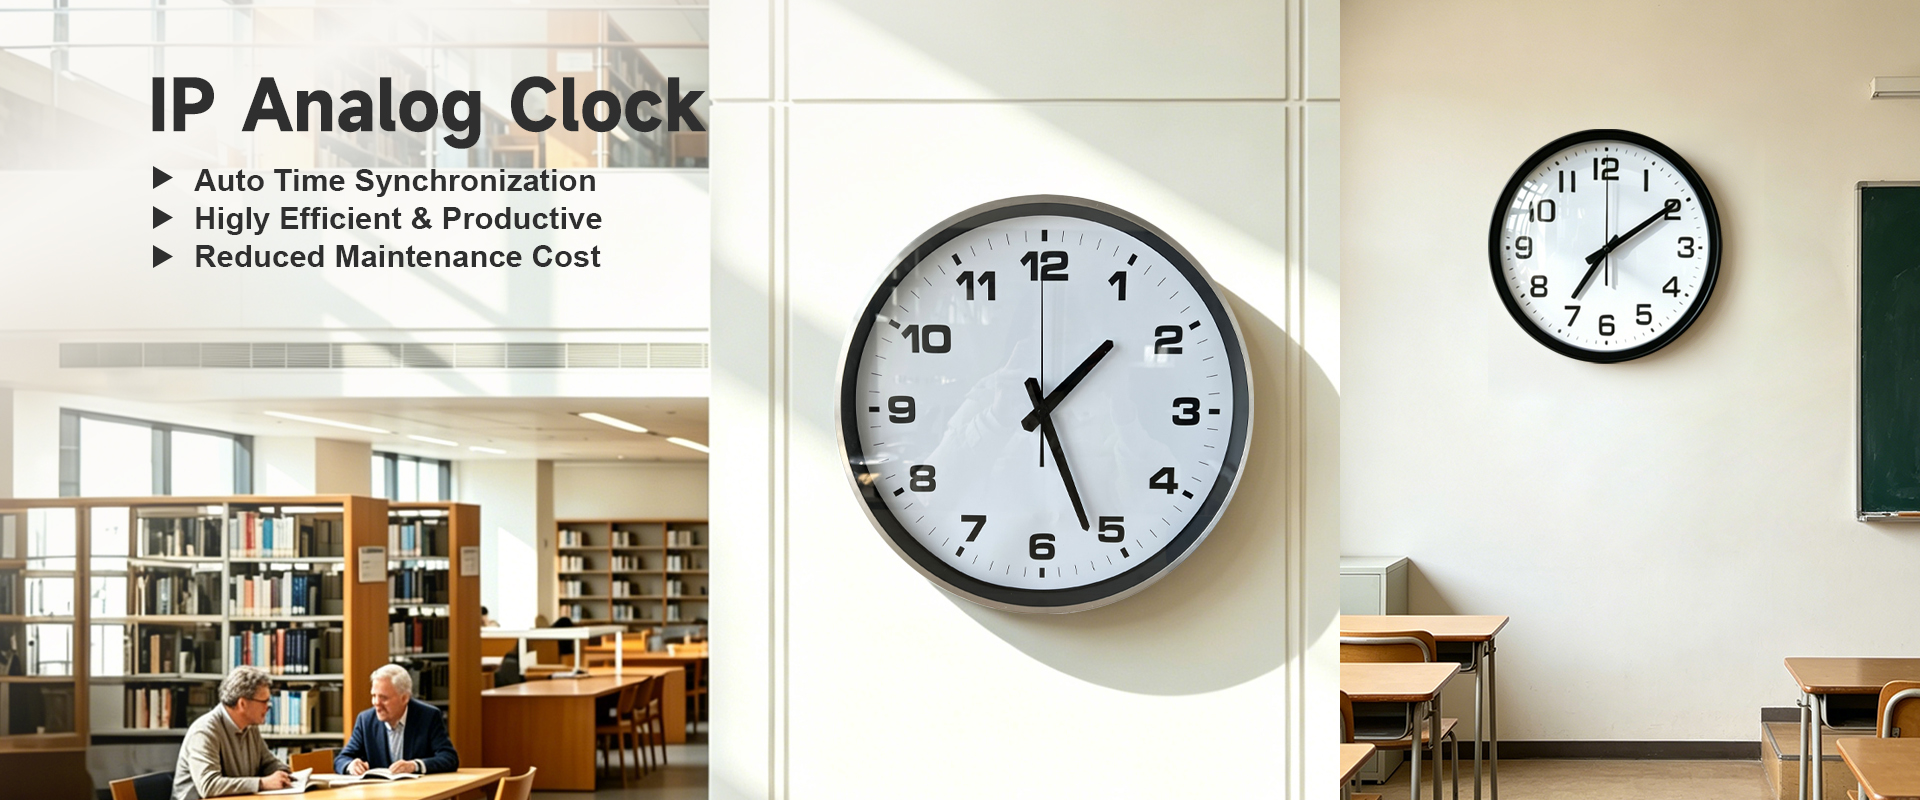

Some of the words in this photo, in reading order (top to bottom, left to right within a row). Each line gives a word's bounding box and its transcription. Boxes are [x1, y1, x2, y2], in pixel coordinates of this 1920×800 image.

[1593, 158, 1619, 180] 12
[1664, 199, 1681, 220] 2
[1515, 236, 1533, 259] 9
[1678, 237, 1694, 258] 3
[1020, 251, 1069, 281] 12
[956, 271, 995, 300] 11
[1108, 271, 1126, 300] 1
[1530, 276, 1547, 297] 8
[1663, 277, 1680, 297] 4
[1565, 306, 1580, 326] 7
[1599, 315, 1615, 336] 6
[1636, 304, 1652, 325] 5
[901, 324, 951, 353] 10
[1155, 326, 1182, 354] 2
[888, 396, 915, 423] 9
[1173, 397, 1200, 425] 3
[910, 465, 936, 492] 8
[1150, 467, 1178, 494] 4
[961, 515, 986, 541] 7
[1098, 516, 1124, 542] 5
[1030, 534, 1055, 560] 6
